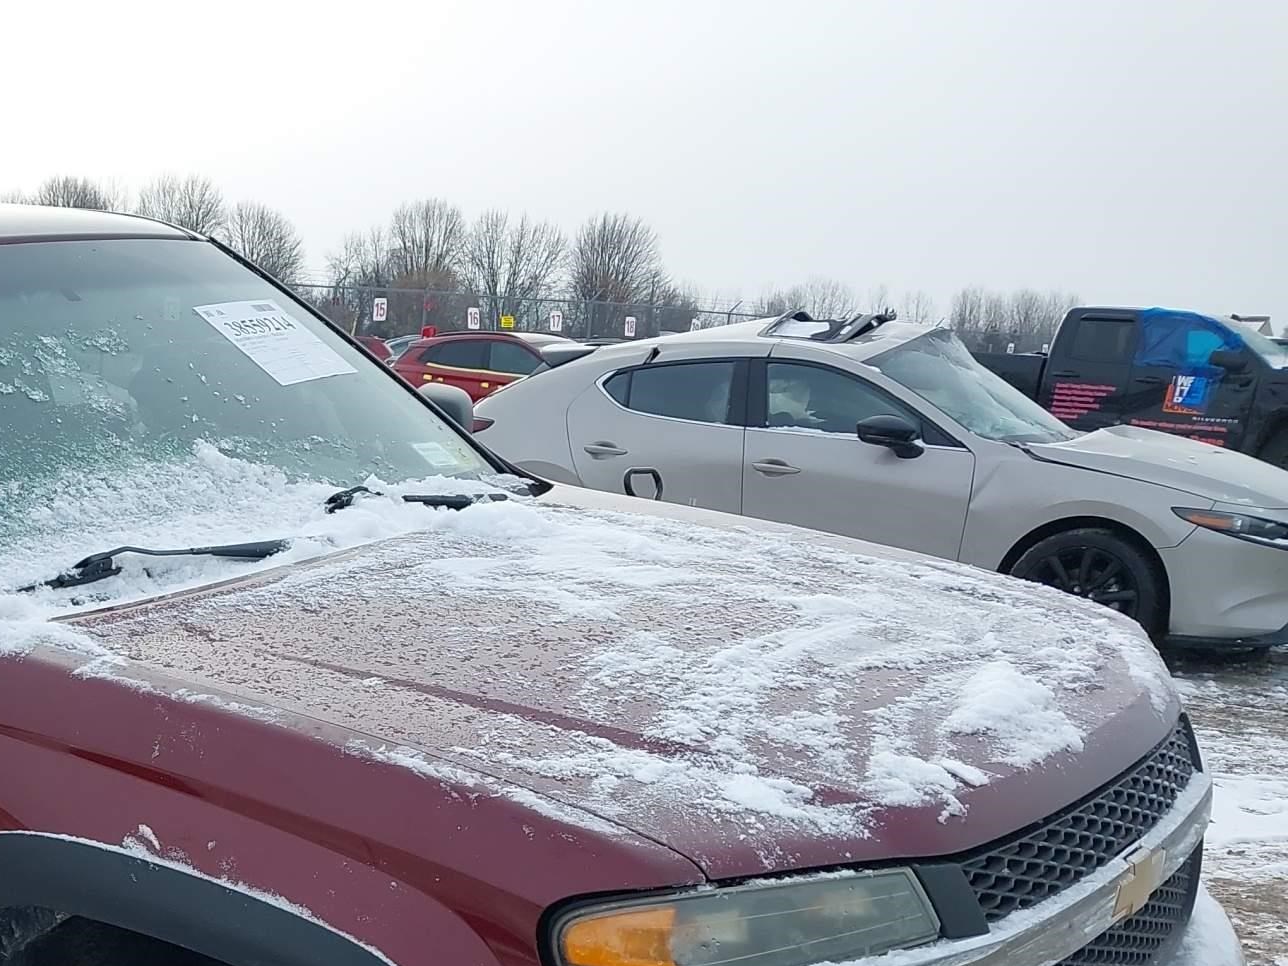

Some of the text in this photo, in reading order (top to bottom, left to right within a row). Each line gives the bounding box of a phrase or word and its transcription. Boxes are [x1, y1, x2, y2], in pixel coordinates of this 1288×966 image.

[374, 302, 386, 318] 15
[223, 316, 297, 337] 38559214
[469, 312, 479, 326] 16
[551, 314, 561, 329] 17
[626, 320, 636, 334] 18
